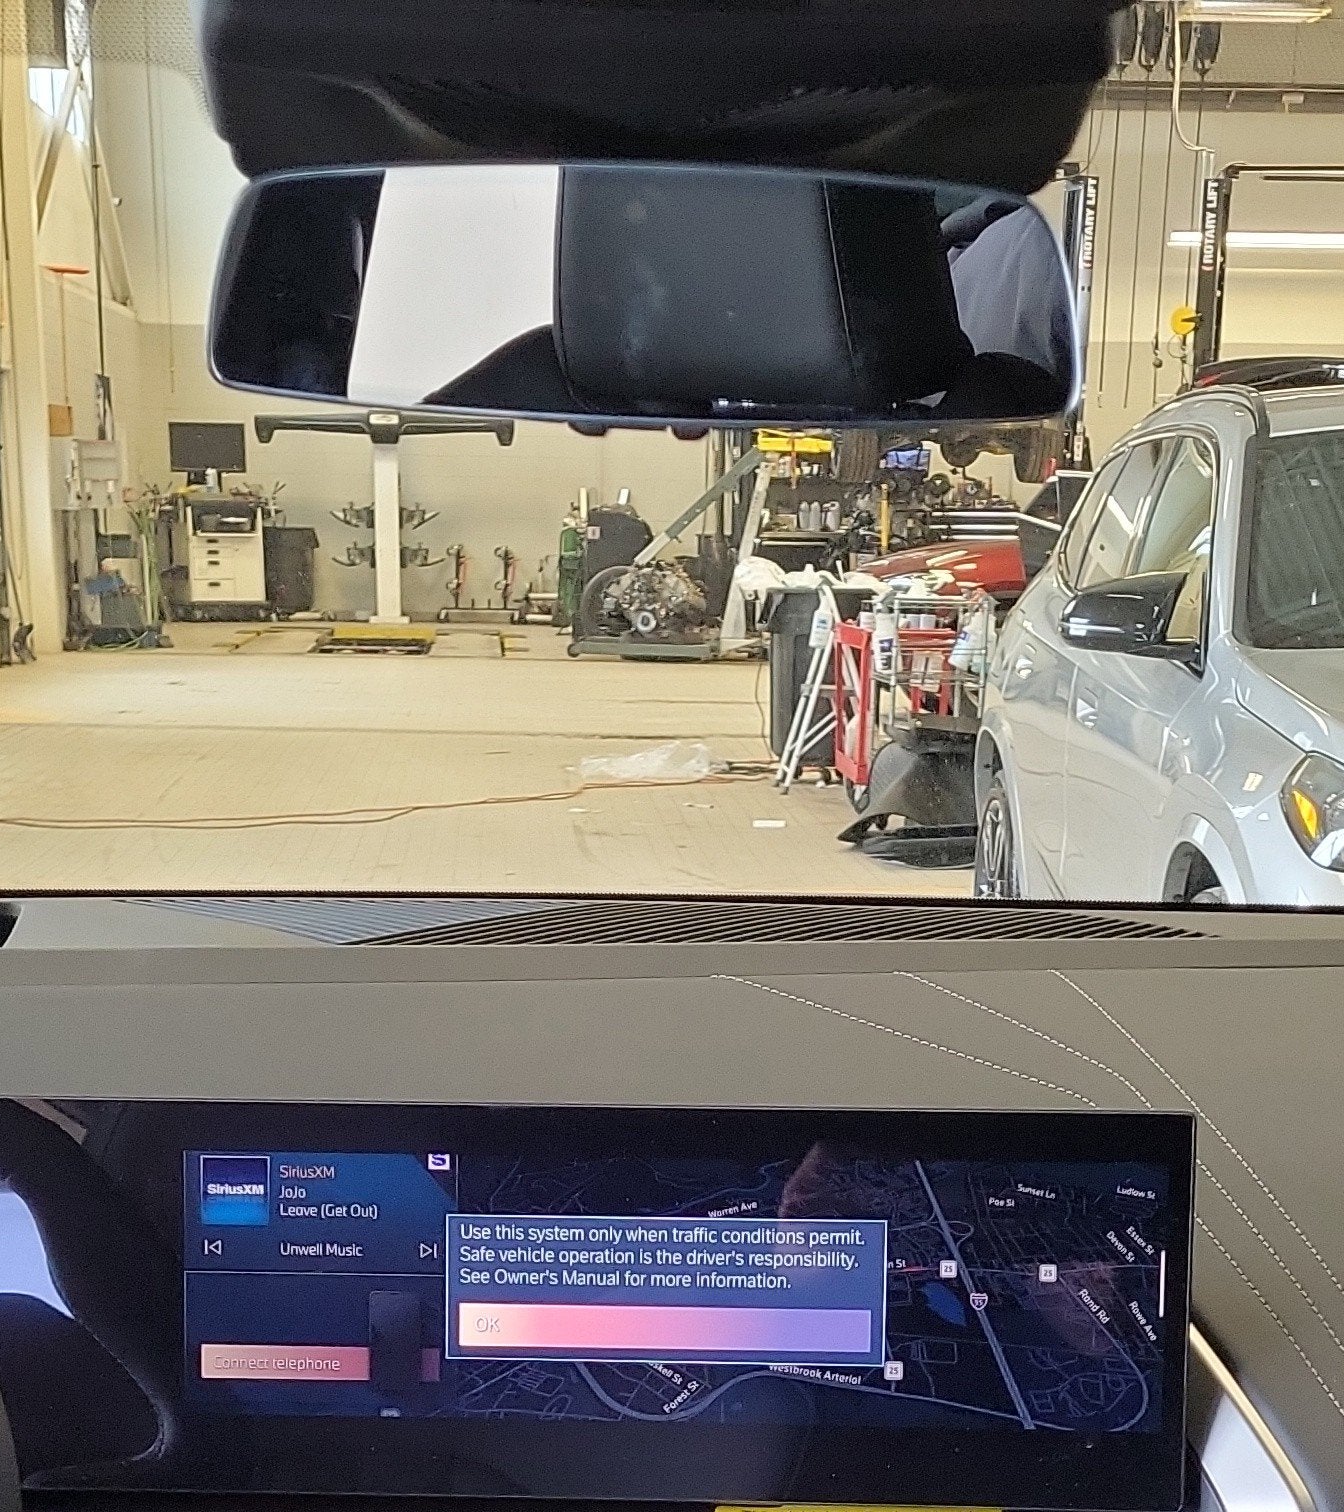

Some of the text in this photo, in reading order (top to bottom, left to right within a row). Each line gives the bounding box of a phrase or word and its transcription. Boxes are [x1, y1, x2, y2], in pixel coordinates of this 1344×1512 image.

[1083, 178, 1098, 261] ROTARY LIFT
[1202, 180, 1219, 264] ROTARY LIFT
[279, 1165, 335, 1180] SiriusXM
[207, 1183, 264, 1195] SiriusXM
[278, 1185, 306, 1199] JoJo
[1017, 1183, 1044, 1196] Sunset
[279, 1203, 378, 1219] Leave (Get Out)
[740, 1200, 758, 1212] Ave
[460, 1223, 865, 1248] Use this system only when traffic conditions permit.
[280, 1242, 363, 1257] Unwell Music
[459, 1245, 859, 1270] Safe vehicle operation is the driver's responsibility.
[895, 1259, 907, 1268] St
[459, 1268, 792, 1288] See Owner's Manual for more information.
[476, 1317, 501, 1333] OK
[213, 1355, 341, 1372] Connect telephone
[671, 1373, 683, 1385] St
[823, 1370, 862, 1385] Arterial
[663, 1381, 699, 1413] Forest St
